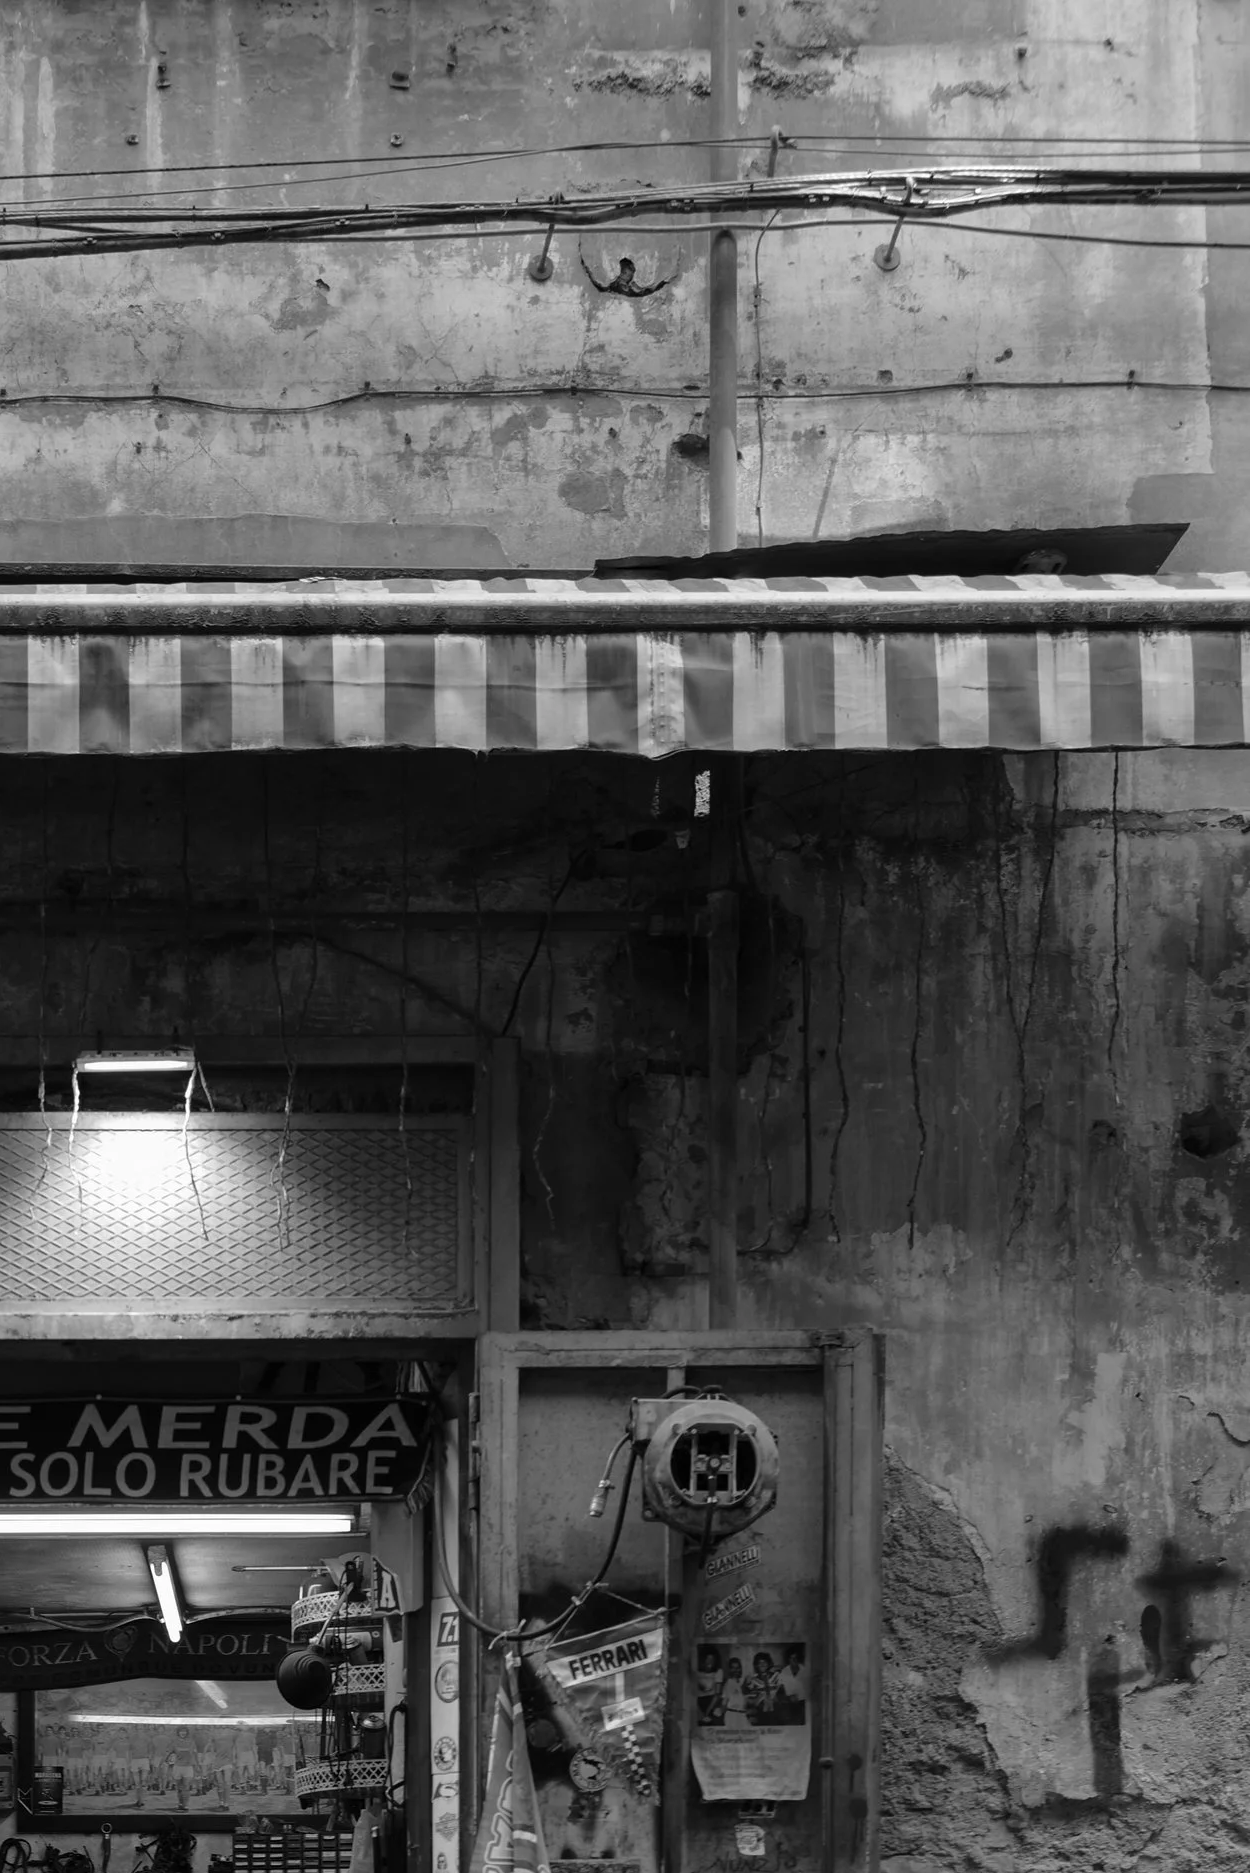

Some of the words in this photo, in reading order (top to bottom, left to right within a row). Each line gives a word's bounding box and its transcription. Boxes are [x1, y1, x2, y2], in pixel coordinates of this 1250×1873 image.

[66, 1402, 417, 1450] MERDA
[8, 1452, 158, 1497] SOLO
[180, 1449, 398, 1497] RUBARE
[148, 1632, 275, 1656] NAPOLI
[568, 1639, 647, 1680] FERRARI
